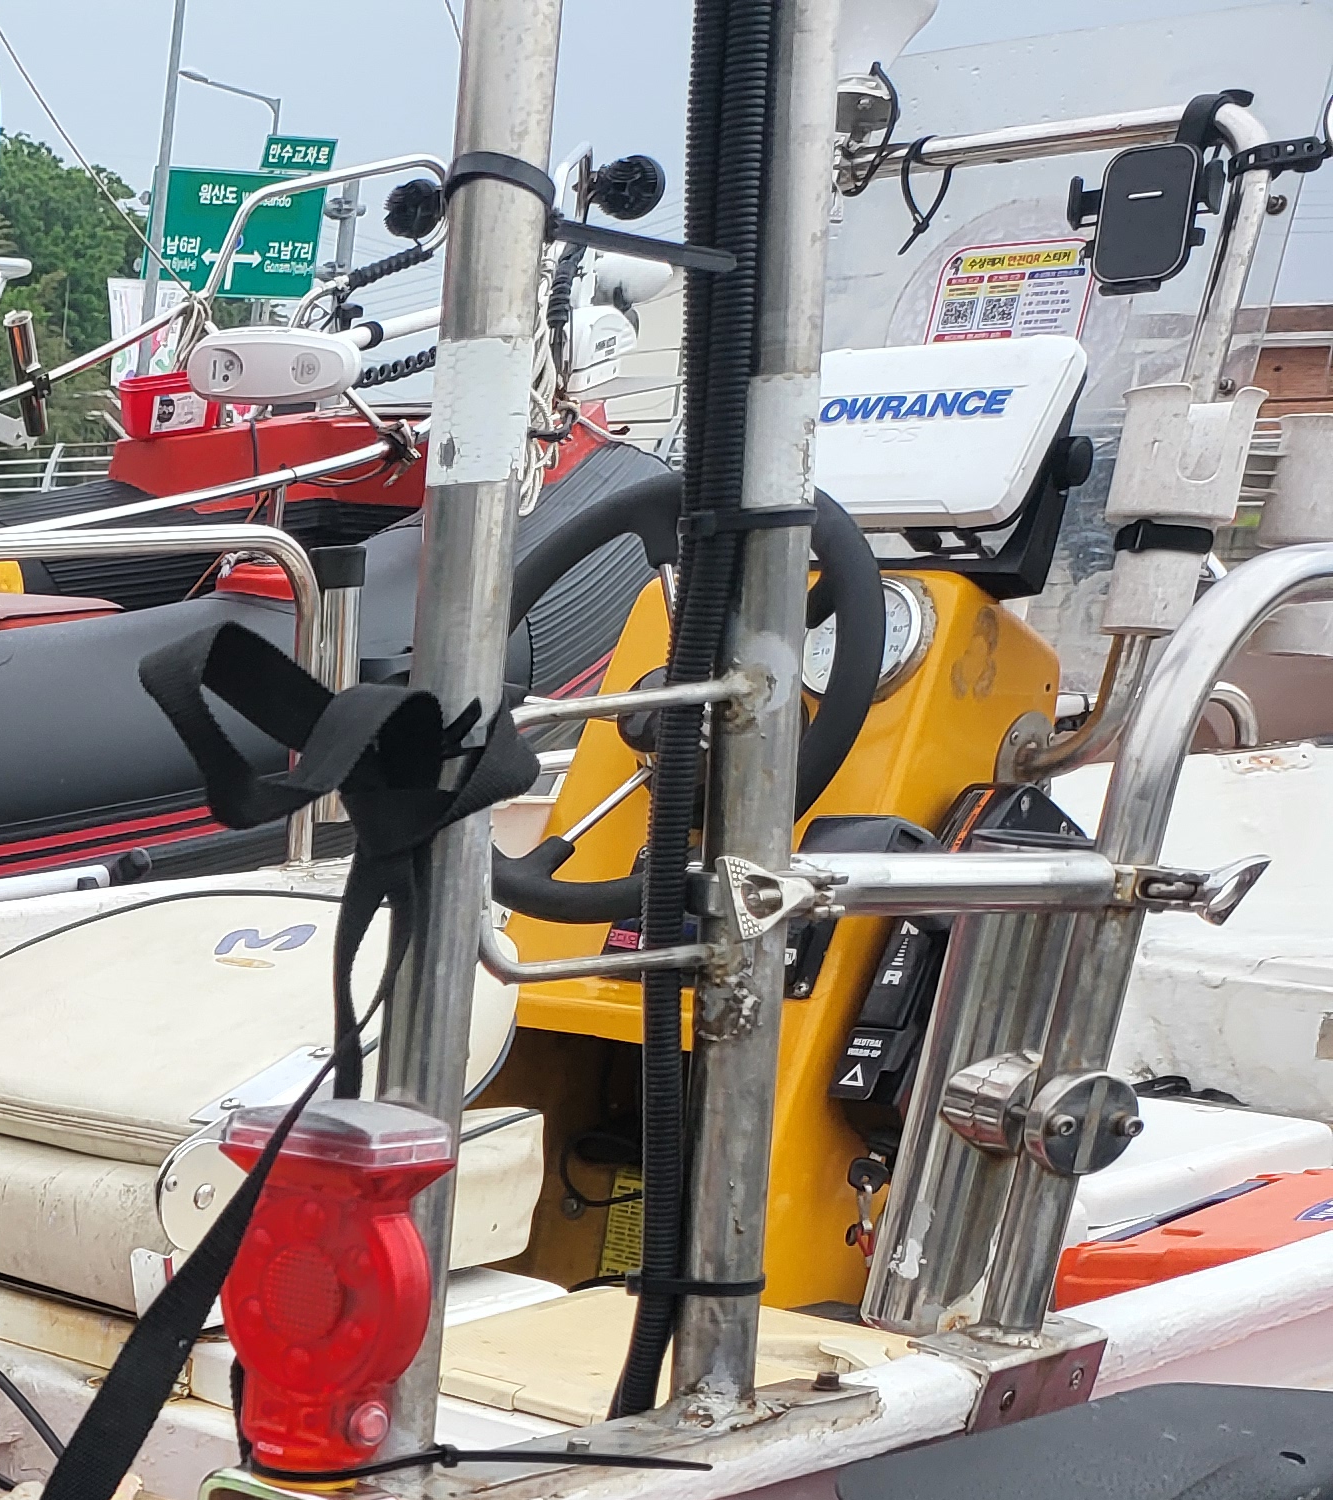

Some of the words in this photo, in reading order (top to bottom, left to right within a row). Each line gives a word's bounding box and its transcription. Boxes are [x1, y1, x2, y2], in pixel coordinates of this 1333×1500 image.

[268, 144, 330, 165] 만수교차로
[198, 183, 238, 205] 원산도
[265, 242, 314, 260] 고남7리
[1007, 253, 1042, 267] 안전QR
[1042, 250, 1072, 264] 스티커
[819, 388, 1014, 424] OWRANCE
[881, 970, 903, 985] R
